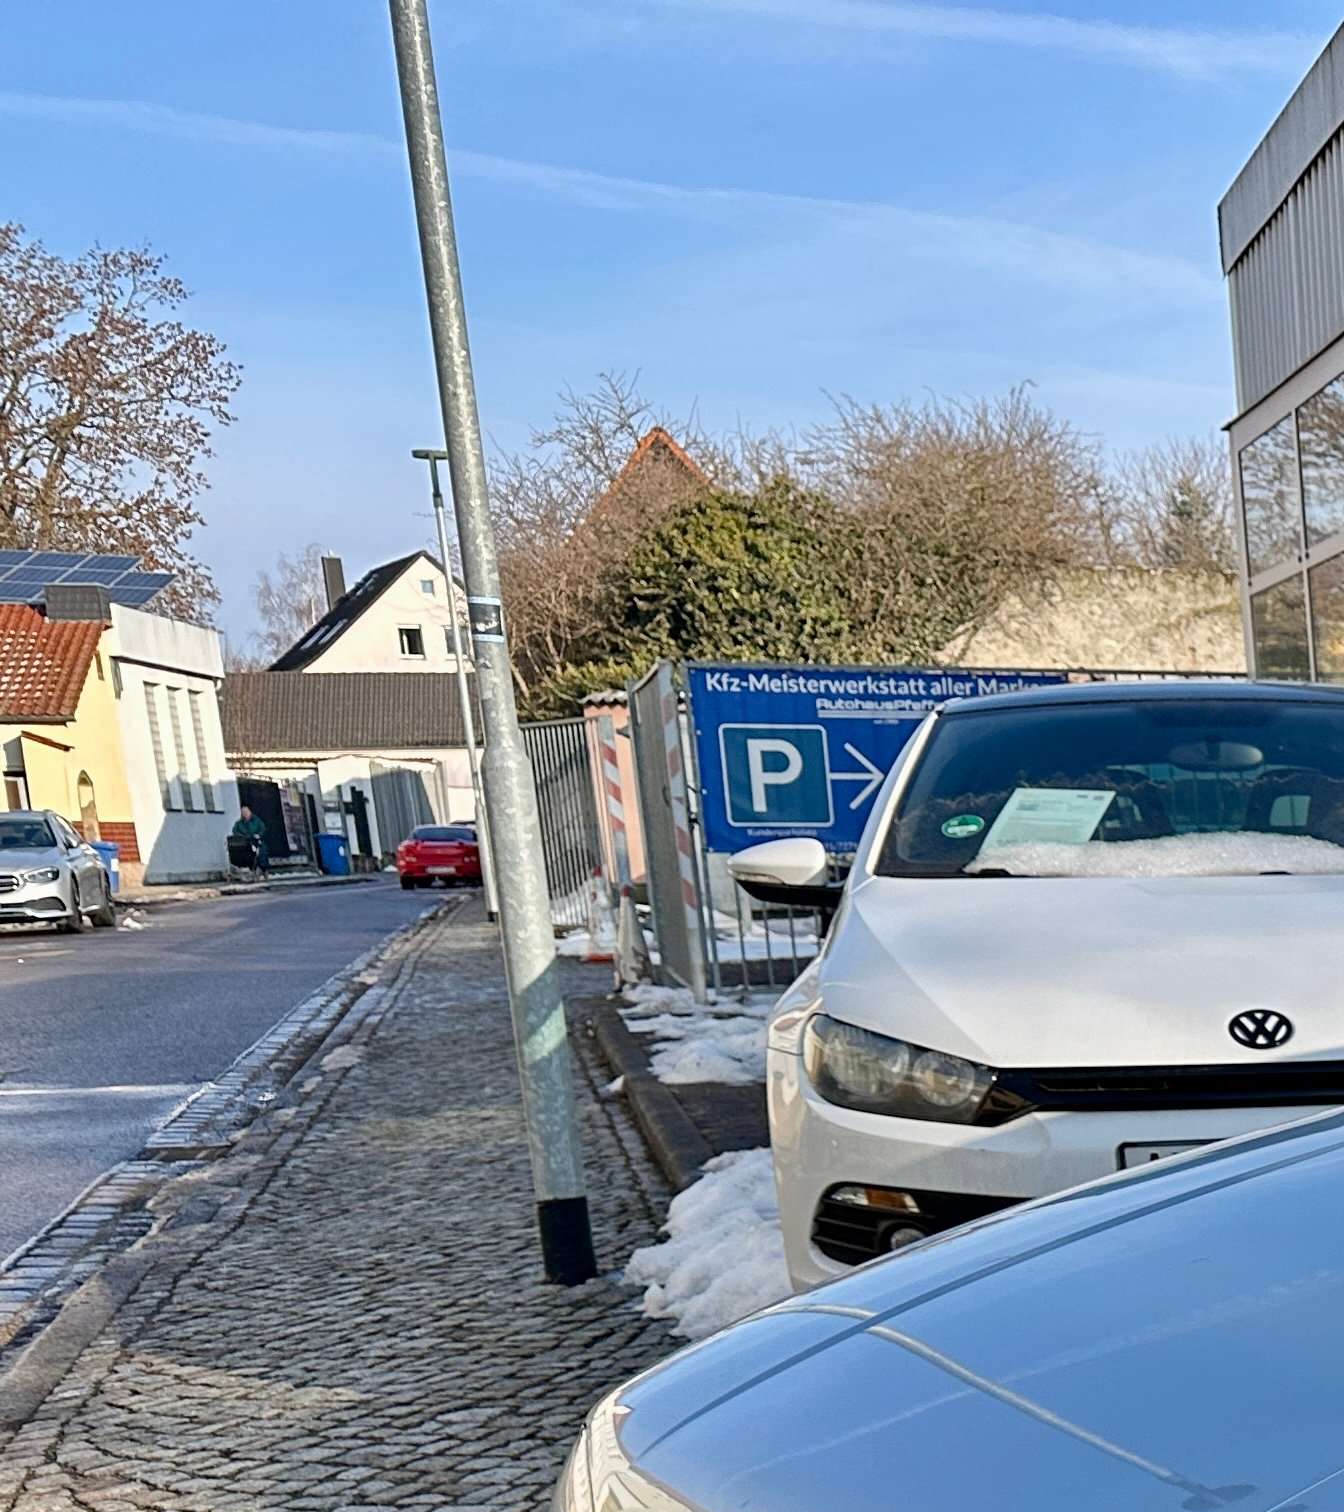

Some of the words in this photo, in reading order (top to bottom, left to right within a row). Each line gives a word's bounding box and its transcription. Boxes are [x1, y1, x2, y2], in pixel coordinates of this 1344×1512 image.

[706, 672, 926, 696] Kfz-Meisterwerkstatt
[930, 677, 974, 696] aller
[978, 678, 1040, 697] Mark
[745, 738, 802, 812] P
